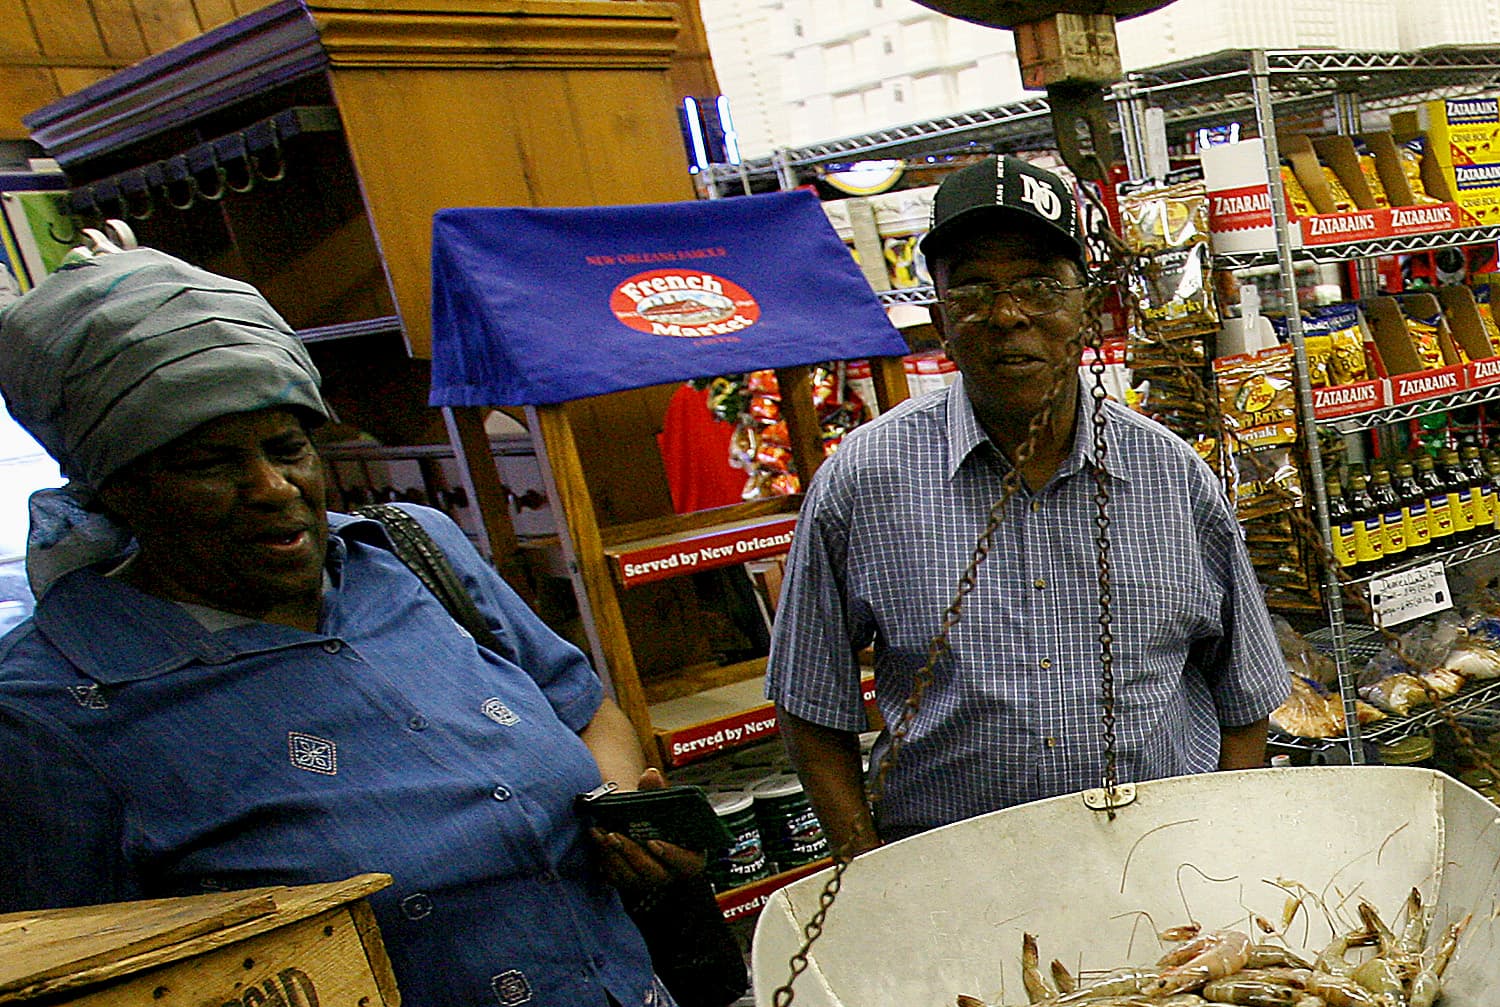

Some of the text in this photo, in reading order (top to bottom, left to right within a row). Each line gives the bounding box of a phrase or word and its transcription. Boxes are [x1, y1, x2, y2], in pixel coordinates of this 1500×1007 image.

[1446, 101, 1499, 117] ZATARAIN'S
[1309, 214, 1376, 236] ZATARAIN'S
[1390, 208, 1452, 228] ZATARAIN'S
[620, 275, 723, 302] French
[651, 314, 753, 337] Market
[1315, 384, 1376, 408] ZATARAIN'S
[1399, 372, 1457, 396] ZATARAIN'S
[623, 554, 679, 577] Served
[680, 551, 699, 567] by
[700, 543, 734, 560] New
[673, 717, 776, 756] Served by New
[722, 895, 761, 919] erved
